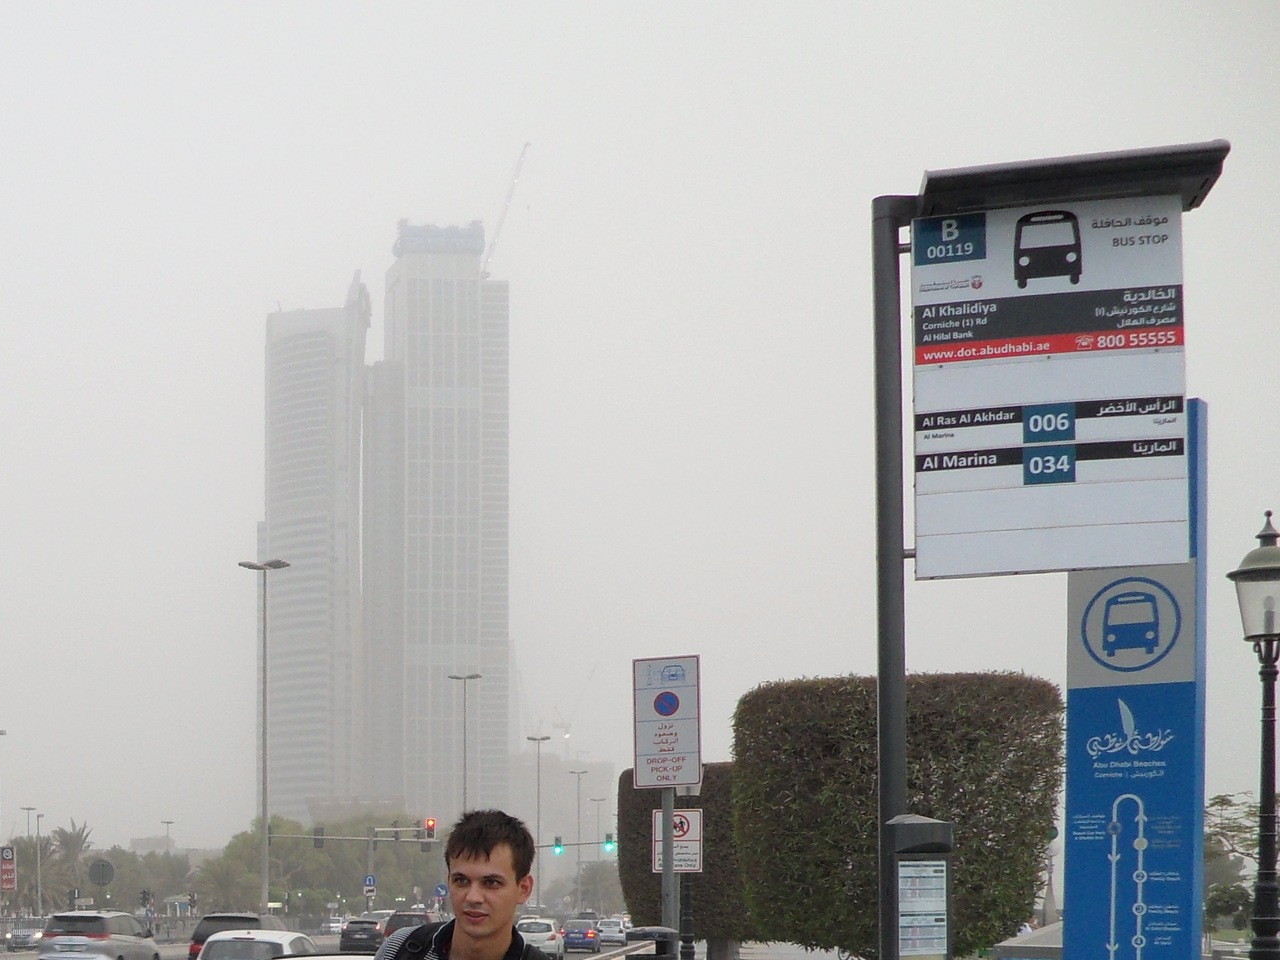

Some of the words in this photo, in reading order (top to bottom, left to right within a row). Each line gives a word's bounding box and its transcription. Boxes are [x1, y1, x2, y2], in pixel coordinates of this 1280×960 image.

[1091, 217, 1132, 229] الحافلة
[1133, 214, 1168, 226] موقف
[941, 219, 959, 241] B
[1112, 237, 1135, 247] BUS
[1138, 234, 1168, 246] STOP
[927, 242, 973, 259] 00119
[1123, 288, 1176, 304] الخالدية
[922, 307, 936, 318] Al
[938, 303, 997, 317] Khalidiya
[1106, 305, 1152, 317] الكورنيش
[1152, 302, 1176, 313] شارع
[922, 320, 960, 330] Corniche
[961, 319, 974, 329] (1)
[976, 317, 987, 326] Rd
[1146, 316, 1176, 327] مصرف
[922, 333, 932, 342] Al
[933, 332, 951, 341] Hilal
[953, 330, 973, 340] Bank
[1097, 335, 1125, 348] 800
[1129, 331, 1176, 346] 55555
[923, 342, 1050, 360] www.dot.abudhabi.ae
[1096, 401, 1137, 416] الأخضر
[1138, 399, 1176, 413] الرأس
[922, 417, 934, 427] Al
[937, 416, 956, 426] Ras
[959, 413, 971, 424] Al
[974, 410, 1015, 422] Akhdar
[1029, 413, 1069, 432] 006
[1132, 441, 1176, 455] المارينا
[922, 456, 938, 470] Al
[942, 453, 997, 468] Marina
[1029, 455, 1070, 474] 034
[646, 756, 687, 765] DROP-OFF
[656, 774, 677, 782] ONLY
